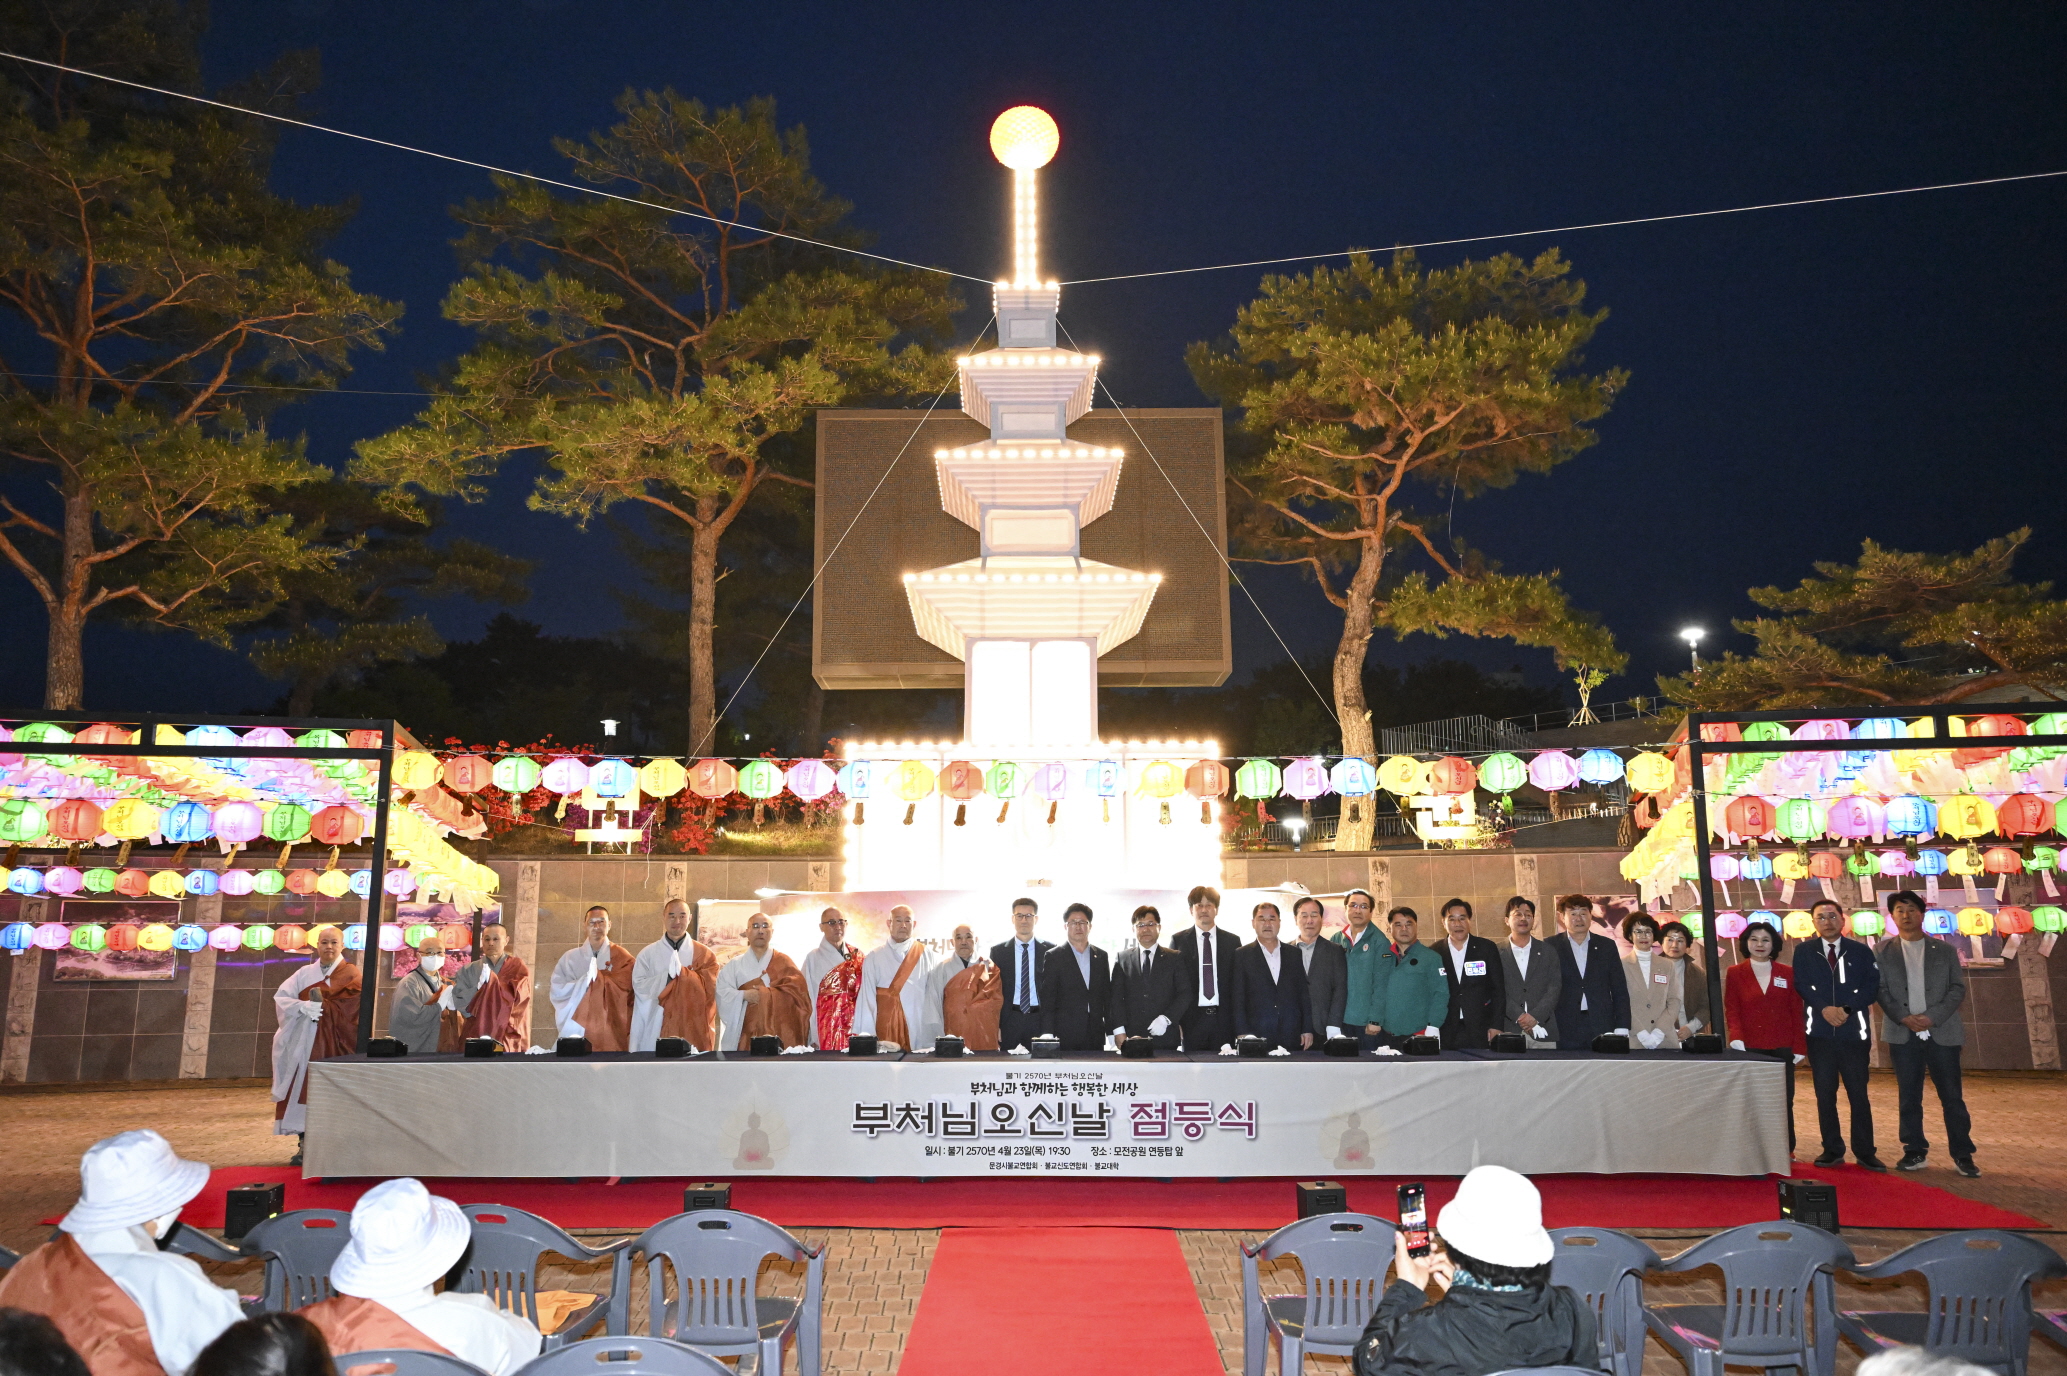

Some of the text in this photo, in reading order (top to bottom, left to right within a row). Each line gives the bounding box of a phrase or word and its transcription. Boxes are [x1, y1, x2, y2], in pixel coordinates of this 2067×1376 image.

[1005, 1072, 1104, 1080] 불기 2570년 부처님오신날
[970, 1082, 1139, 1097] 부처님과 함께하는 행복한 세상
[852, 1101, 1256, 1138] 부처님오신날 점등식
[924, 1146, 942, 1157] 일시
[947, 1146, 964, 1157] 불기
[966, 1146, 996, 1157] 2570년
[997, 1146, 1012, 1157] 4월
[1013, 1146, 1046, 1157] 23일(목)
[1048, 1146, 1071, 1156] 19:30
[1090, 1146, 1108, 1157] 장소
[1113, 1146, 1147, 1158] 모전공원
[1148, 1146, 1174, 1158] 연등탑
[1174, 1146, 1184, 1157] 앞
[989, 1161, 1120, 1171] 문경시불교연합회 불교신도연합회 불교대학
